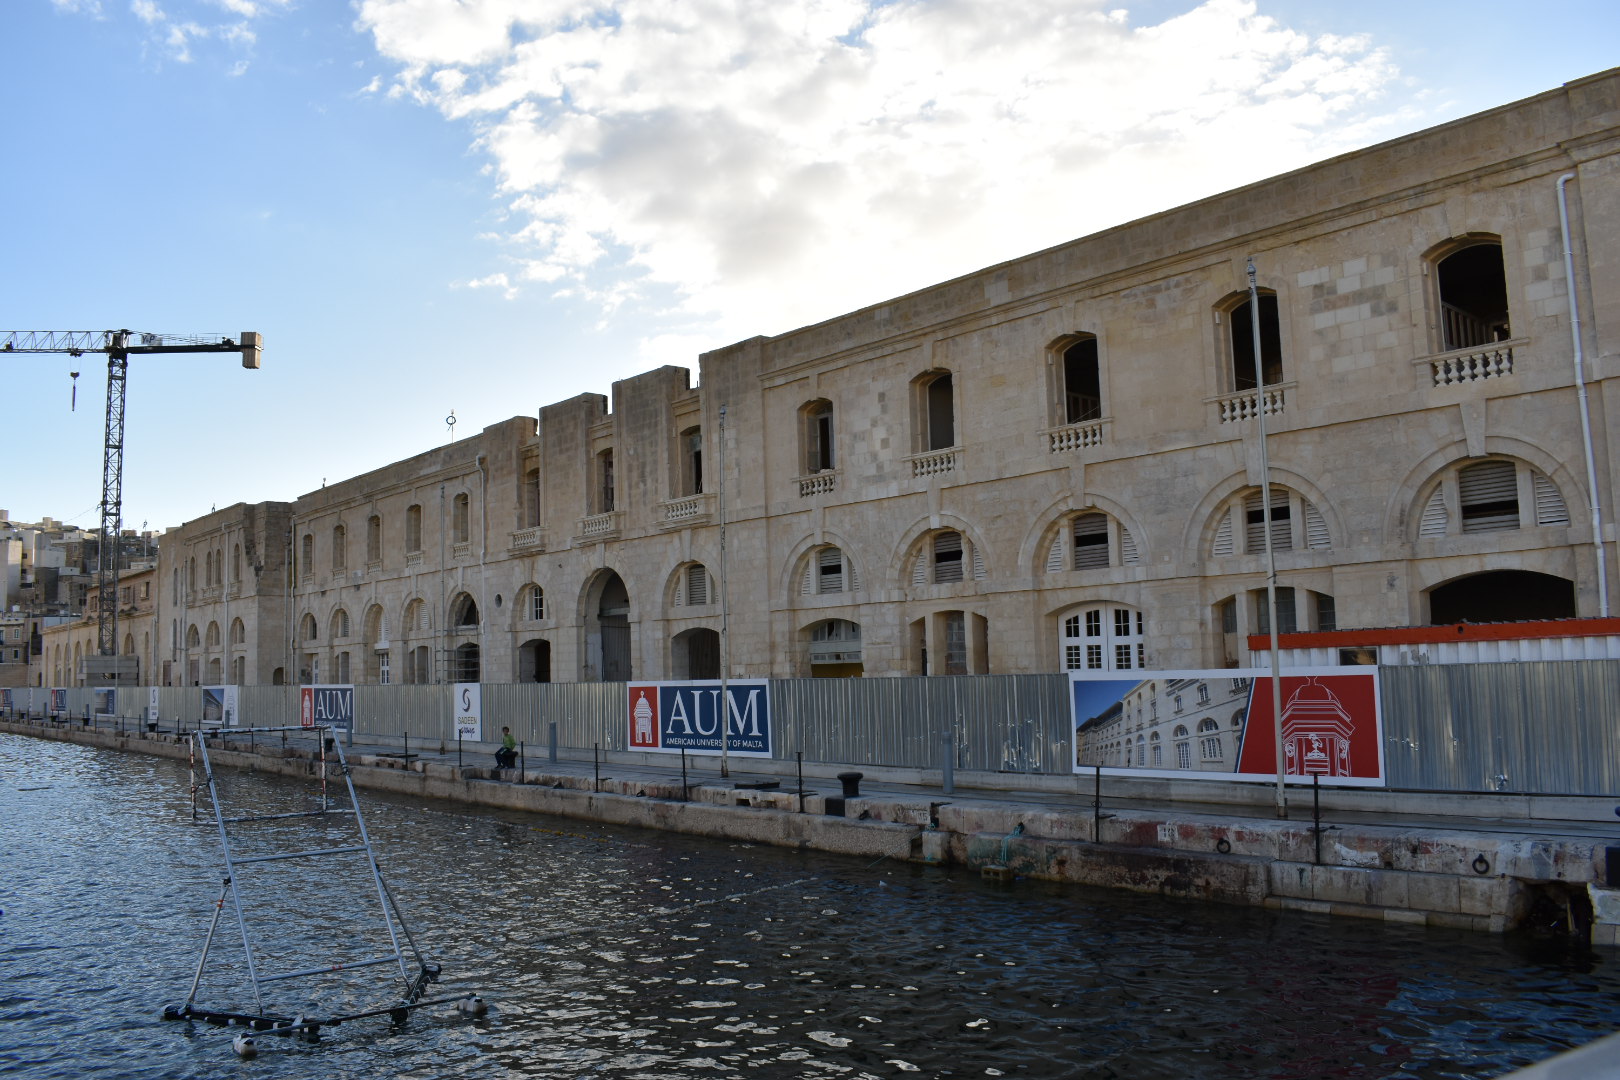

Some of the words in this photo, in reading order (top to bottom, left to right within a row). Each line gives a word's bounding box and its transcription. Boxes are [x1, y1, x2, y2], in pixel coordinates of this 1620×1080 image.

[315, 690, 351, 719] AUM
[666, 689, 763, 736] AUM
[666, 737, 696, 746] AMERICAN
[696, 739, 732, 747] UNIVERSY
[732, 739, 741, 747] OF
[742, 740, 763, 748] MALTA
